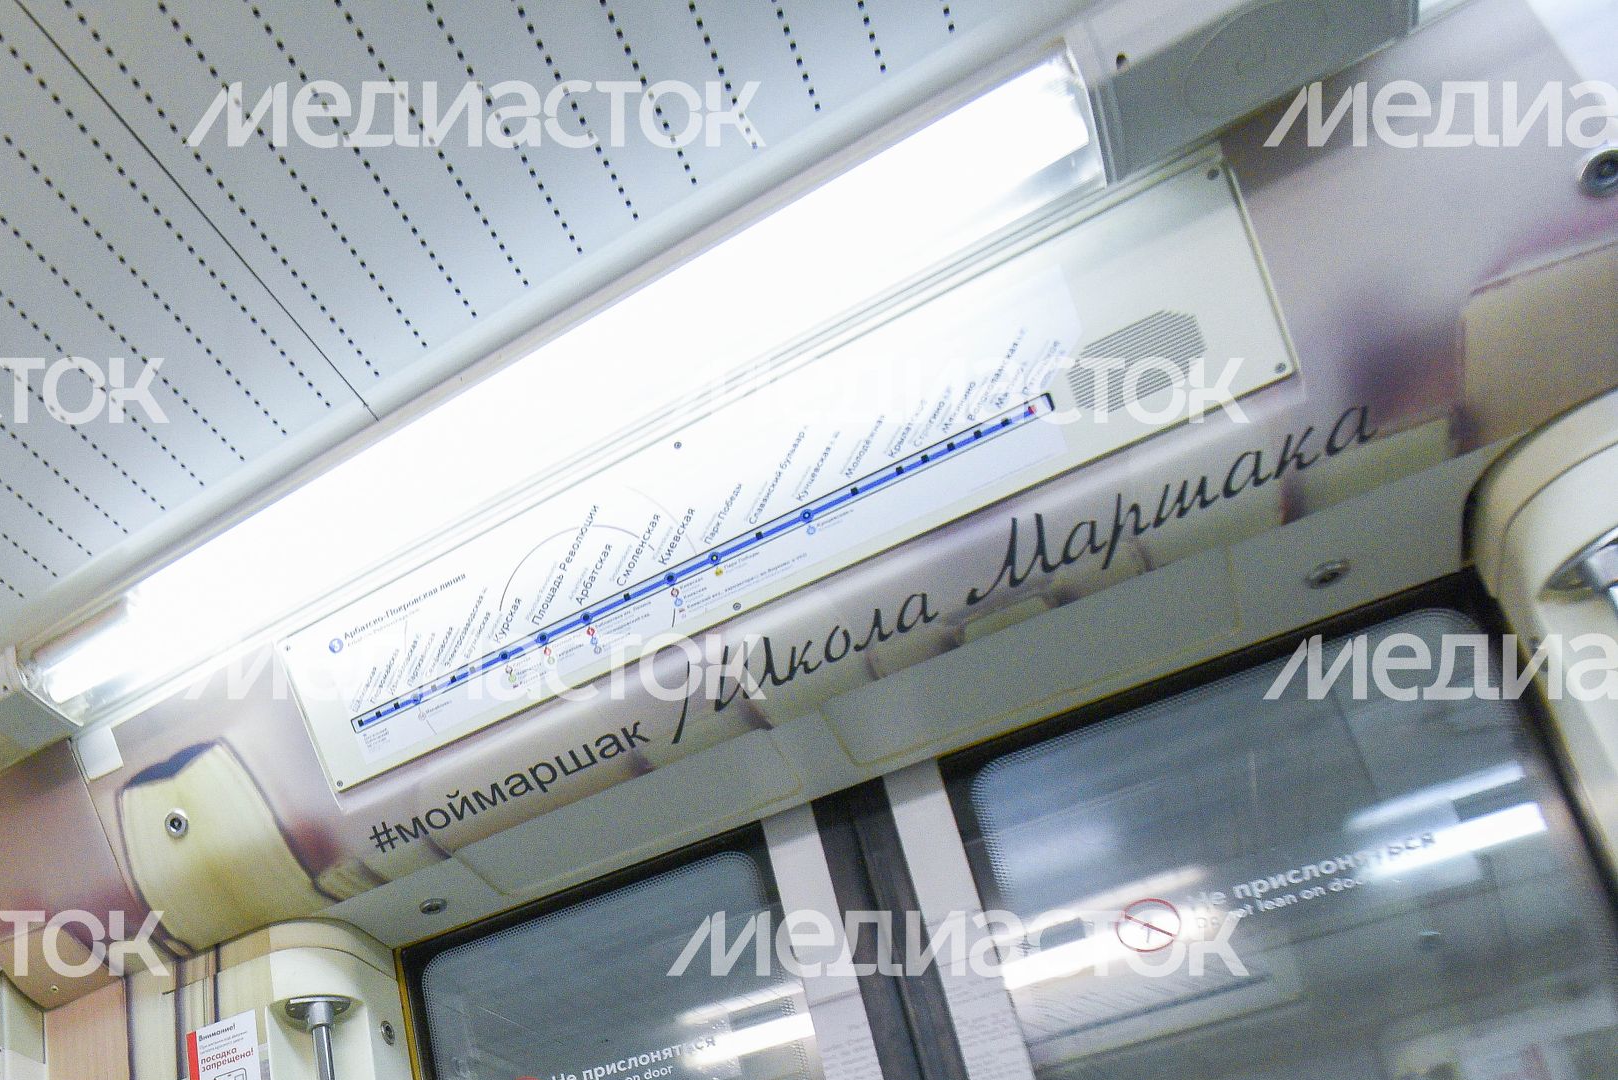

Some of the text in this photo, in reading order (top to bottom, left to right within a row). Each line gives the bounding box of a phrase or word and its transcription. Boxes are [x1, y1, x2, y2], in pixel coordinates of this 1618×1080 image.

[658, 507, 695, 566] Киевская
[704, 482, 743, 545] Парк Победы
[532, 503, 599, 626] Площадь Революции
[617, 513, 661, 586] Смоленская
[576, 543, 612, 605] Арбатская
[369, 720, 650, 854] #моймаршак
[714, 590, 940, 712] Школа
[966, 405, 1378, 606] Маршака
[494, 597, 522, 643] Курская
[1256, 889, 1297, 913] lean
[1299, 885, 1326, 901] on
[198, 1023, 236, 1041] Внимание!
[201, 1047, 237, 1064] посадка
[202, 1048, 254, 1072] запрещена!
[582, 1036, 717, 1080] прислонятся
[644, 1065, 674, 1080] door
